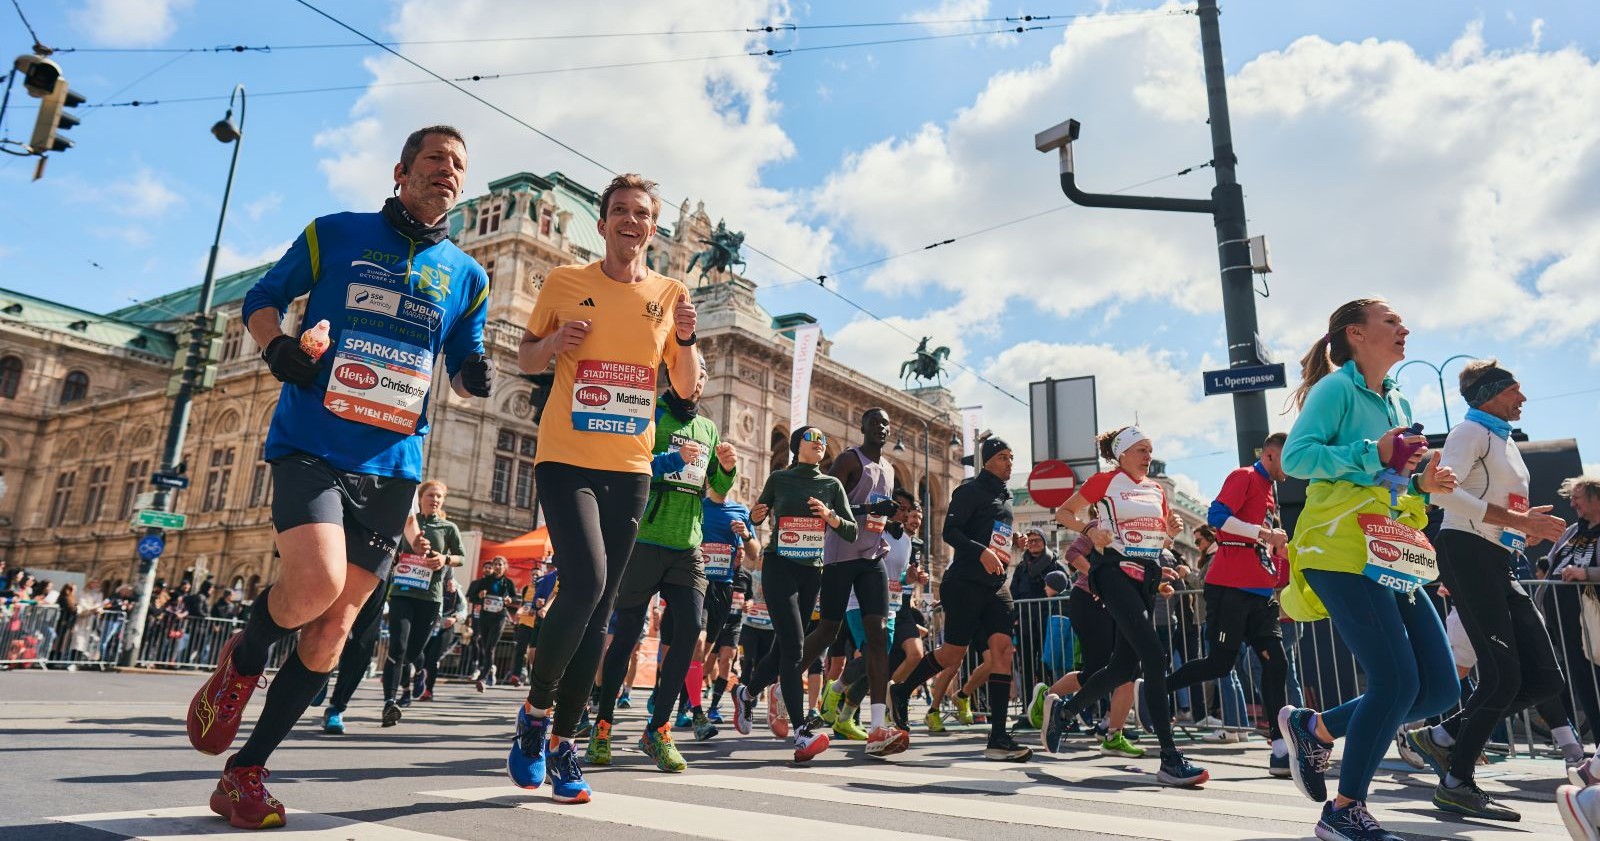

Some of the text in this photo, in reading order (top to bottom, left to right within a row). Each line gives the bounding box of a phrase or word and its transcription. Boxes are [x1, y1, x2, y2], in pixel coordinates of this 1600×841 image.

[362, 249, 400, 265] 2017
[359, 273, 388, 281] OCTOBER
[366, 269, 391, 278] SUNDAY
[370, 292, 384, 301] sse
[344, 338, 423, 367] SPARKASSE
[601, 362, 636, 373] WIENER
[339, 366, 375, 385] Hervis
[583, 369, 635, 382] STÄDTISCHE
[1224, 374, 1274, 388] Operngasse
[579, 390, 651, 406] Hervis Matthias
[354, 404, 414, 428] WIEN ENERGIE
[588, 418, 625, 432] ERSTE
[1372, 542, 1435, 569] Hervis Heather
[411, 567, 430, 578] Katja
[1377, 574, 1414, 592] ERSTE
